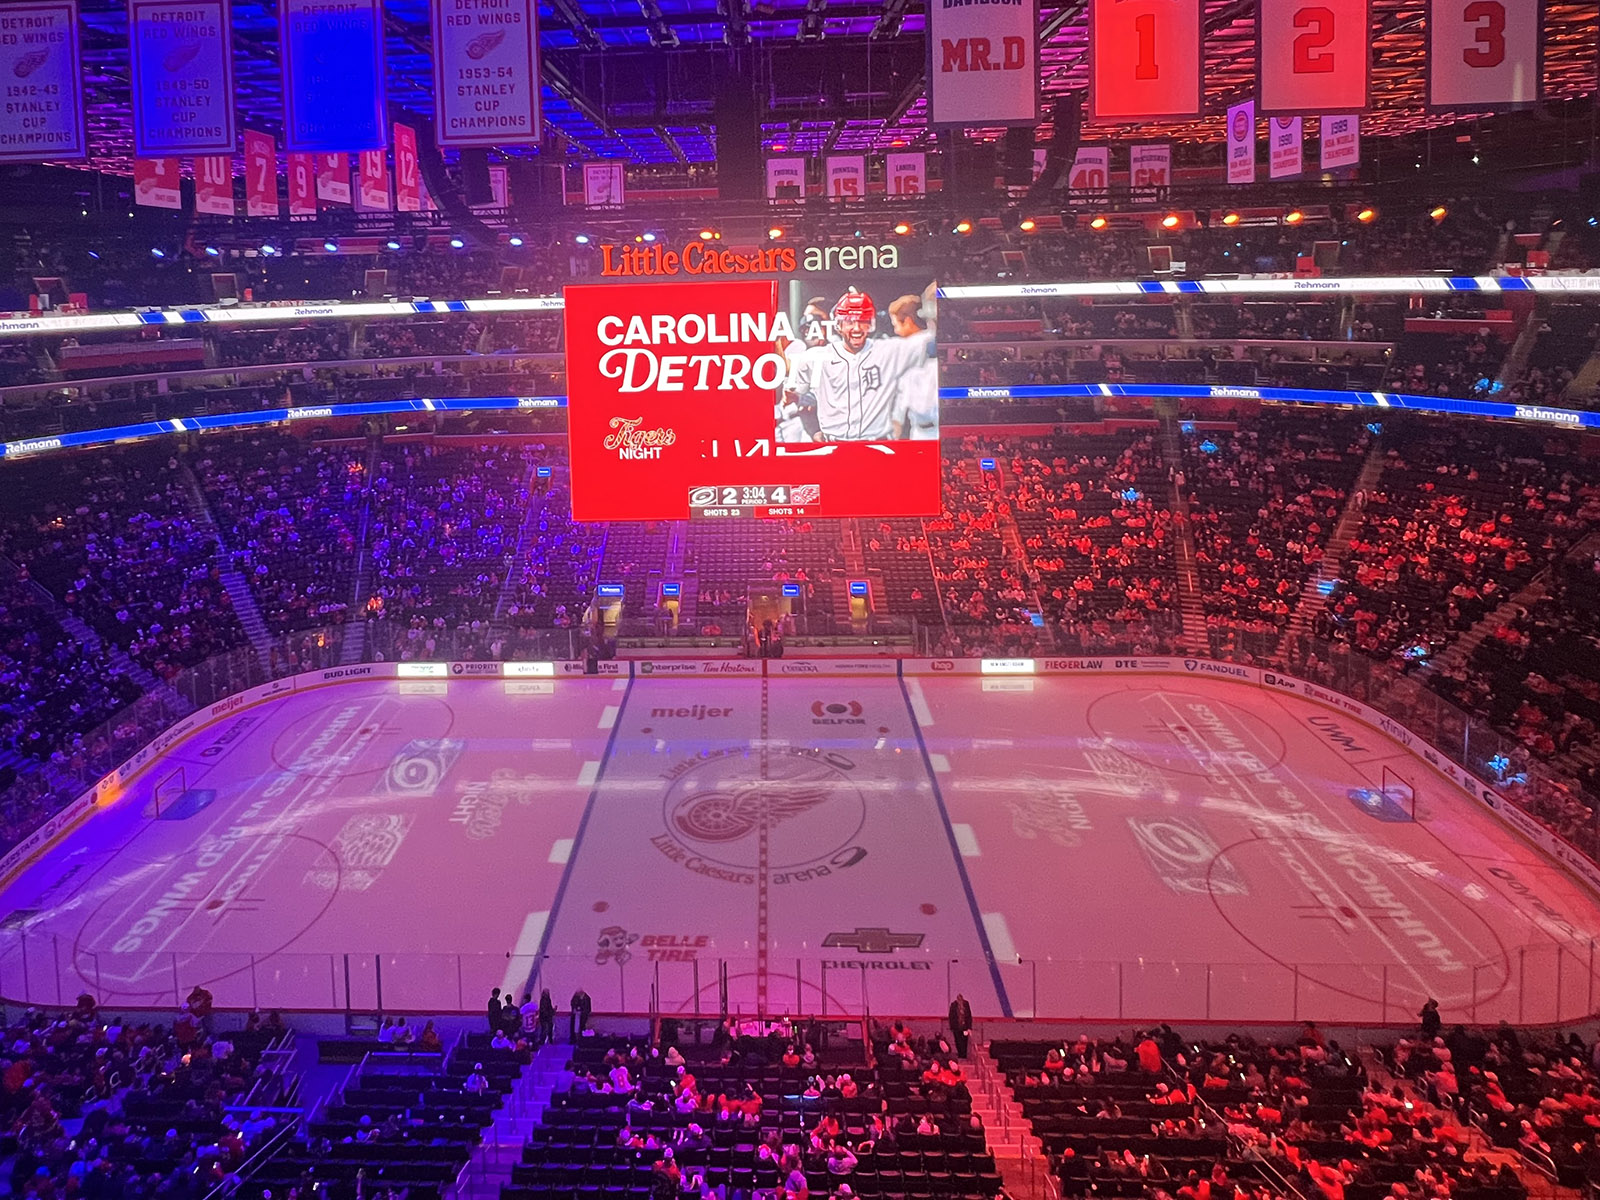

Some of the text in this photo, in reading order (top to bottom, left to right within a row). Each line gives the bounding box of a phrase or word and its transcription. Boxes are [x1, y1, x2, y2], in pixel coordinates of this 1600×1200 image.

[455, 0, 512, 10] DETROIT
[2, 17, 54, 29] DETROIT
[151, 11, 206, 22] DETROIT
[447, 12, 521, 26] RED WINGS
[0, 32, 65, 45] ED WINGS
[174, 26, 216, 38] WINGS
[1463, 1, 1505, 68] 3
[1135, 13, 1159, 80] 1
[1293, 7, 1335, 74] 2
[941, 36, 1025, 73] MR.D
[458, 67, 514, 80] 1953-54
[457, 84, 515, 96] STANLEY
[6, 103, 60, 114] STANLEY
[155, 96, 211, 107] STANLEY
[474, 100, 500, 112] CUP
[22, 117, 47, 129] CUP
[172, 112, 197, 123] CUP
[451, 115, 526, 129] CHAMPIONS
[1, 131, 72, 145] CHAMPIONS
[255, 158, 267, 192] 7
[400, 150, 415, 187] 12
[296, 166, 308, 198] 9
[894, 176, 919, 198] 16
[834, 178, 858, 202] 15
[600, 241, 898, 277] Little Caesars arena
[1294, 281, 1340, 289] Rehmann
[0, 322, 40, 330] hmann
[596, 311, 794, 346] CAROLINA
[598, 347, 826, 393] DETROIT
[968, 388, 1010, 397] Rehmann
[1210, 387, 1259, 398] Rehmann
[518, 398, 558, 407] Rehmann
[287, 408, 332, 418] Rehmann
[1515, 406, 1579, 423] Rehmann
[603, 416, 677, 450] Tigers
[6, 438, 61, 454] Rehmann
[619, 447, 663, 460] NIGHT
[722, 487, 737, 504] 2
[743, 487, 765, 499] 3:04
[771, 487, 787, 503] 4
[703, 662, 757, 672] Tim Hortons
[1115, 660, 1137, 668] DTE
[1200, 663, 1249, 678] FANDUEL
[324, 667, 371, 679] BUD LIGHT
[211, 696, 244, 716] meijer
[652, 705, 733, 720] meijer
[1185, 703, 1246, 749] WINGS
[1379, 717, 1413, 746] xfinity
[1308, 716, 1370, 753] UWM
[1232, 750, 1281, 784] RED
[448, 781, 489, 825] NIGHT
[191, 826, 247, 866] RED
[650, 834, 832, 885] Little Caesars arena
[107, 871, 208, 953] WINGS
[640, 935, 709, 947] BELLE
[647, 949, 698, 962] TIRE
[821, 960, 933, 971] CHEVROLET
